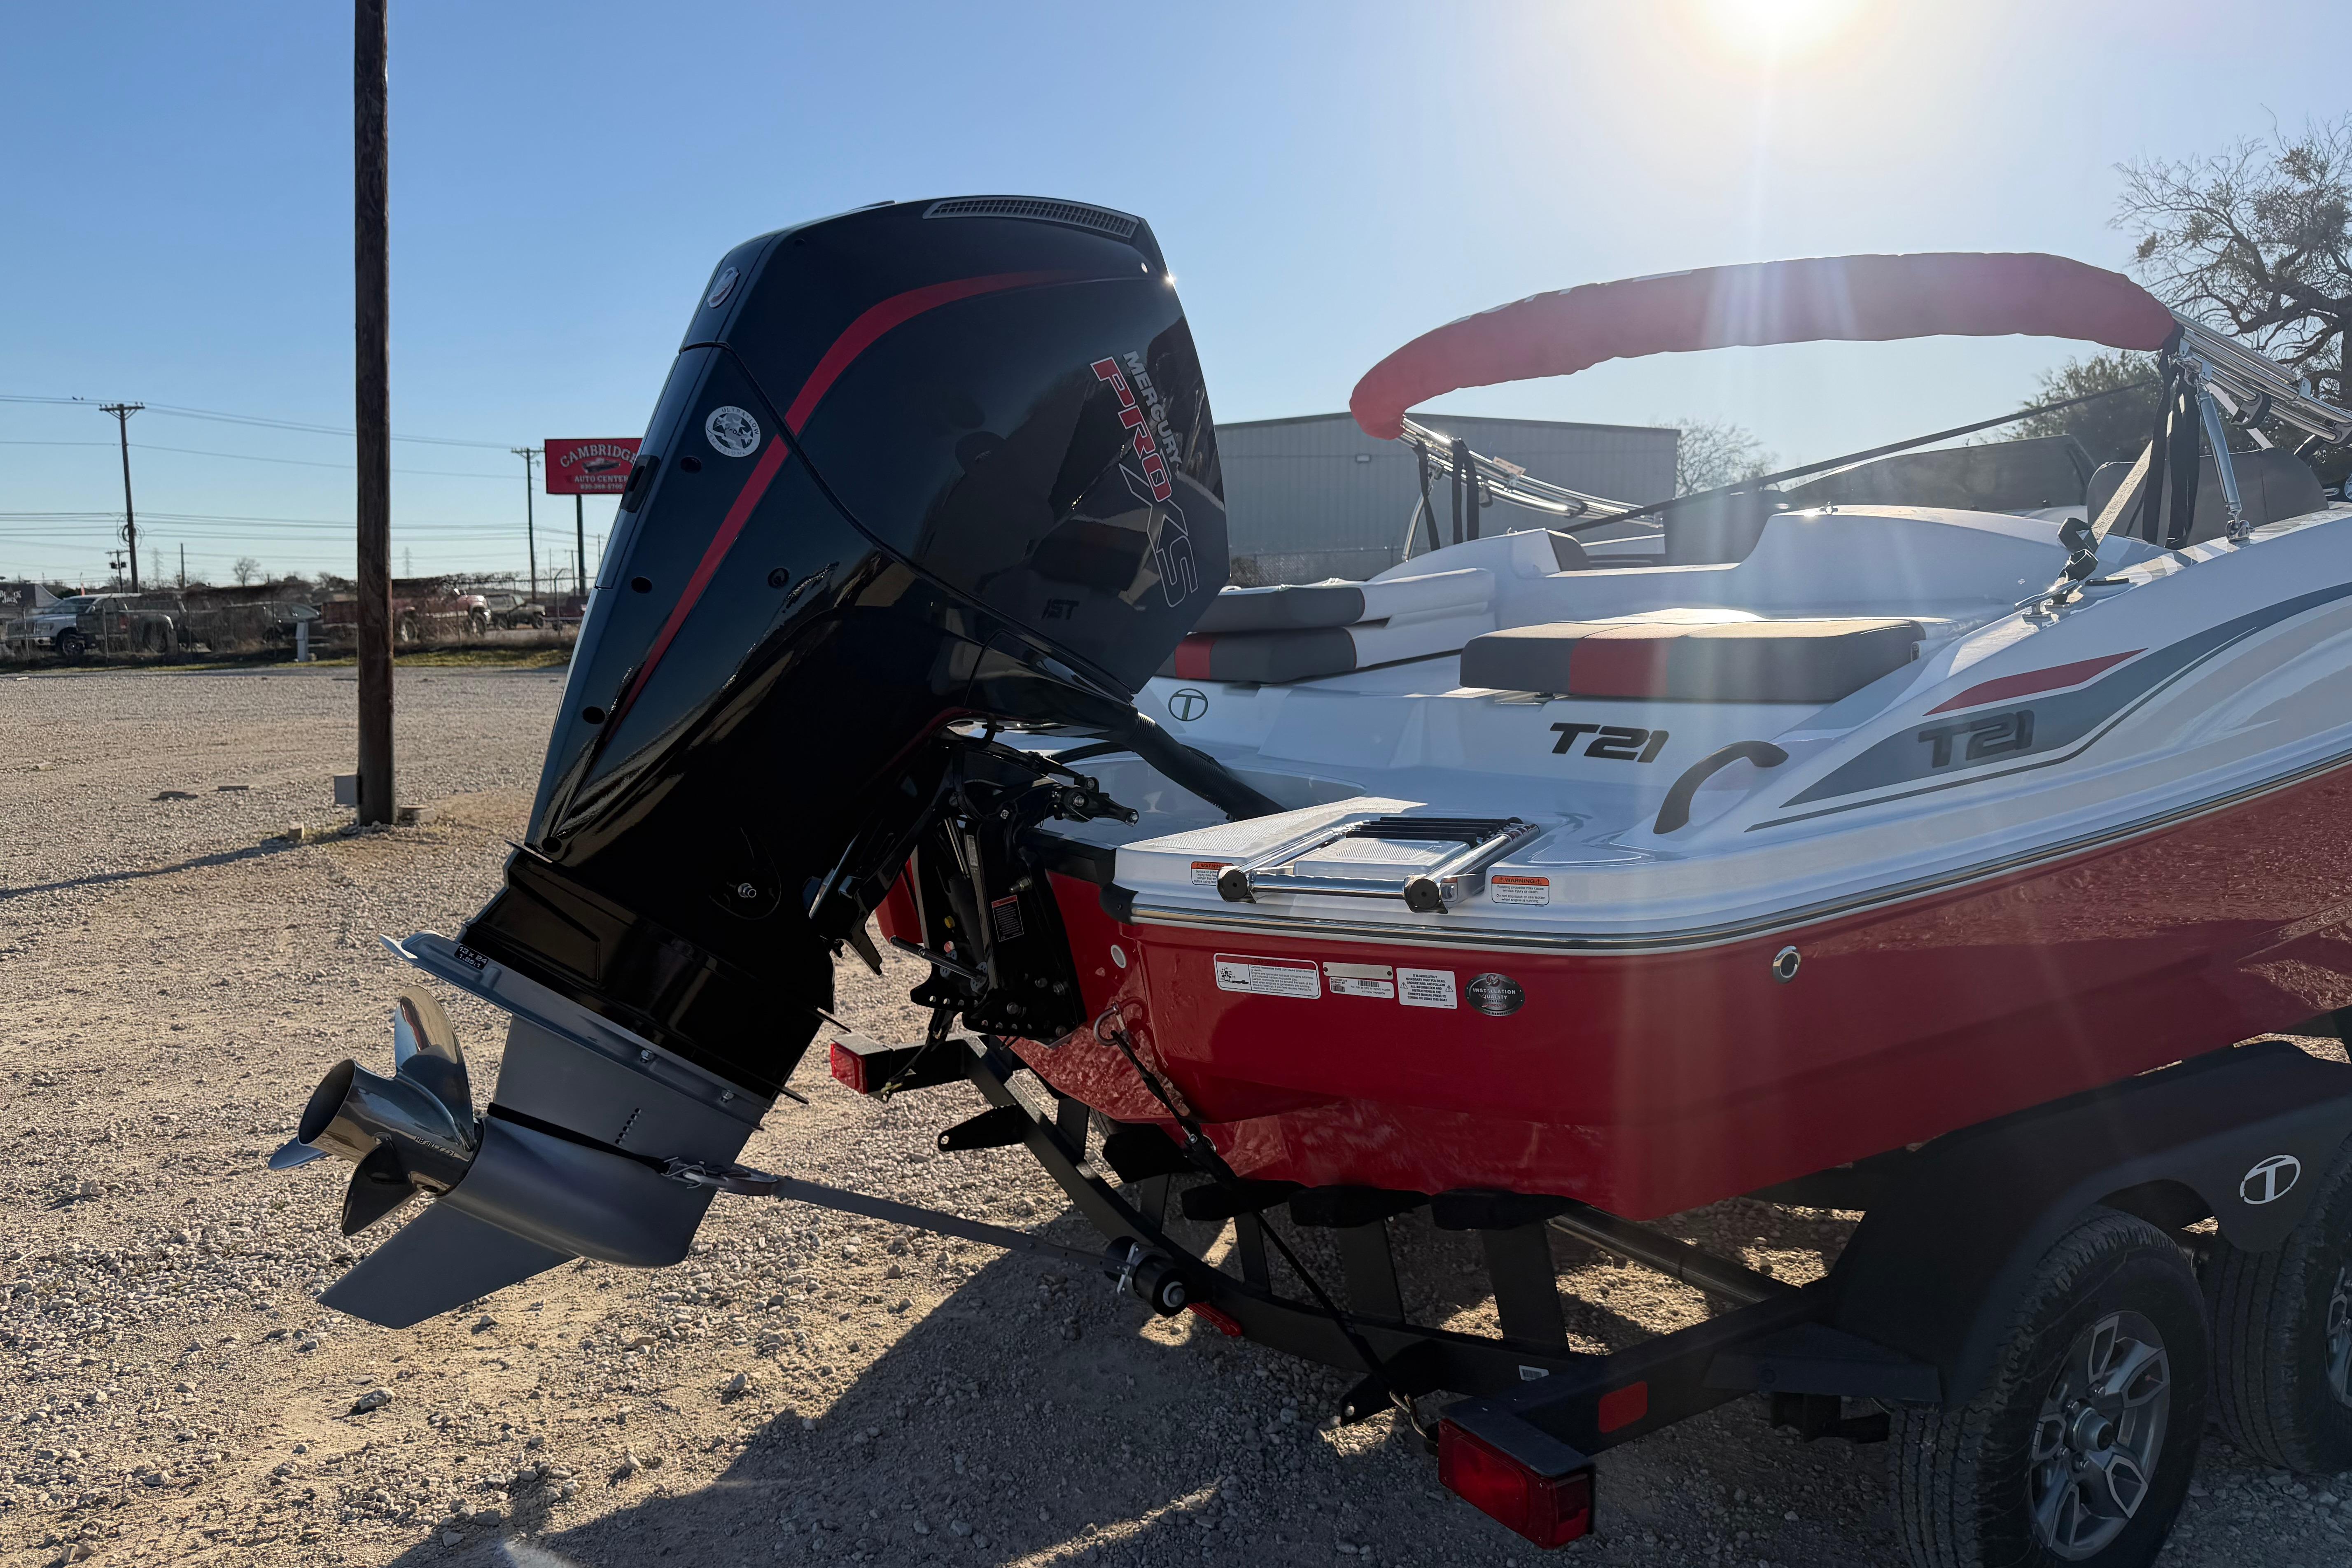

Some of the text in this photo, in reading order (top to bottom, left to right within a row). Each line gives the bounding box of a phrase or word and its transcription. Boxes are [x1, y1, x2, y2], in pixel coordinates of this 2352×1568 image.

[722, 408, 745, 417] ULTRA
[749, 419, 759, 434] LOW
[1090, 356, 1172, 502] PRO
[1122, 351, 1182, 464] MERCURY
[1118, 448, 1198, 607] XS
[1549, 722, 1669, 763] T21
[1918, 709, 2035, 768] T21
[460, 954, 481, 967] 1.85:1
[475, 955, 487, 964] 24
